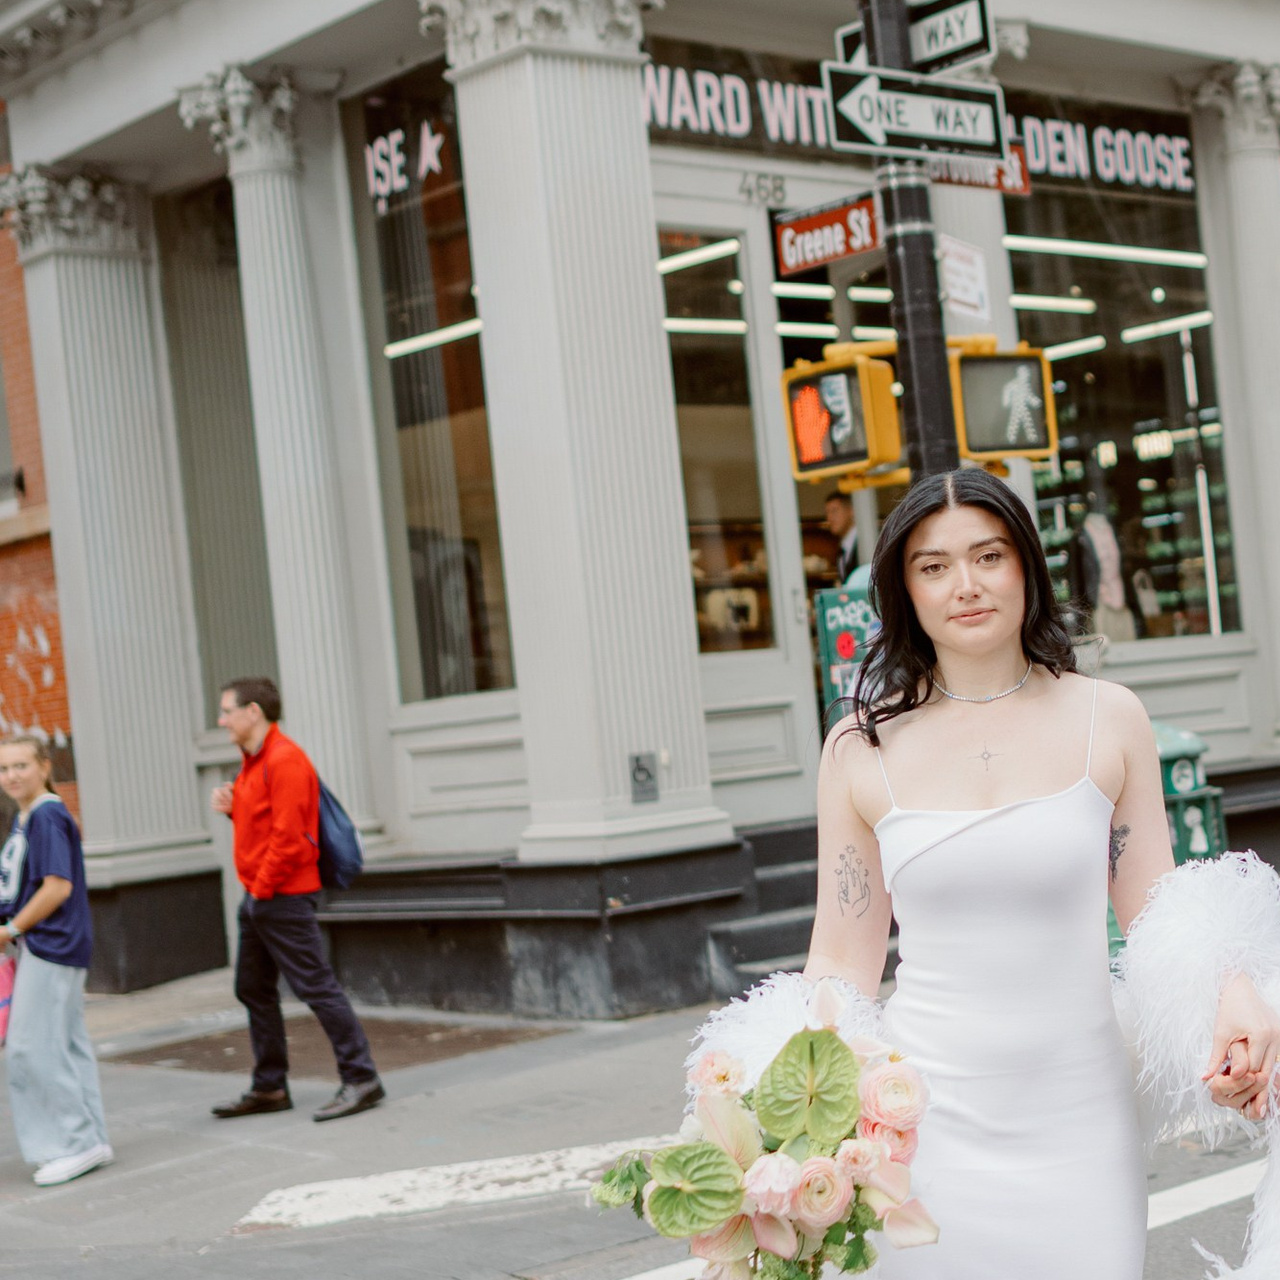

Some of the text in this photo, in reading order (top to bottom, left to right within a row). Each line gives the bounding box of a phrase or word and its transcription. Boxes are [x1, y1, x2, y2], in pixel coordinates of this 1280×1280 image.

[923, 10, 968, 51] WAY
[858, 94, 981, 134] ONE WAY
[1093, 125, 1195, 191] GOOSE
[739, 171, 786, 207] 468
[781, 222, 846, 269] Greene
[847, 207, 874, 251] St
